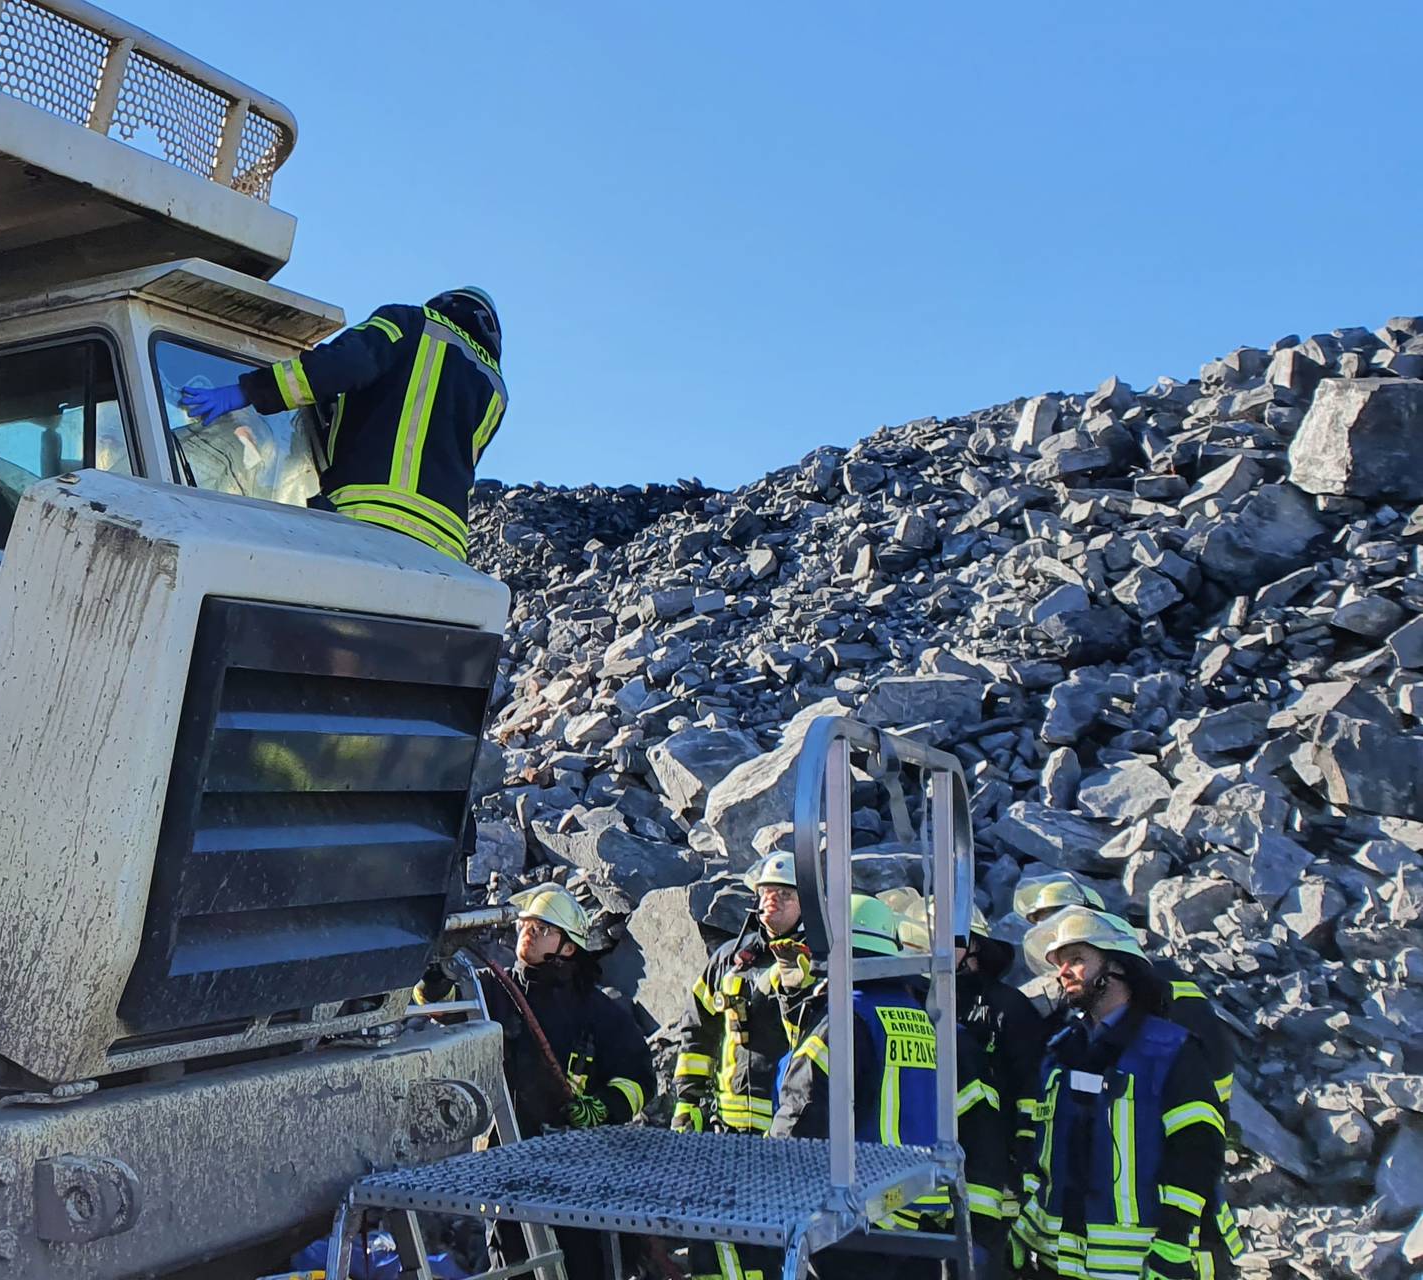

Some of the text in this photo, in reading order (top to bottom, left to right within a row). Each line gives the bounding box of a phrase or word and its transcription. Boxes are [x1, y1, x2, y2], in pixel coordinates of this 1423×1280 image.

[890, 1039, 897, 1062] 8
[900, 1040, 912, 1062] LF
[914, 1042, 927, 1064] 20
